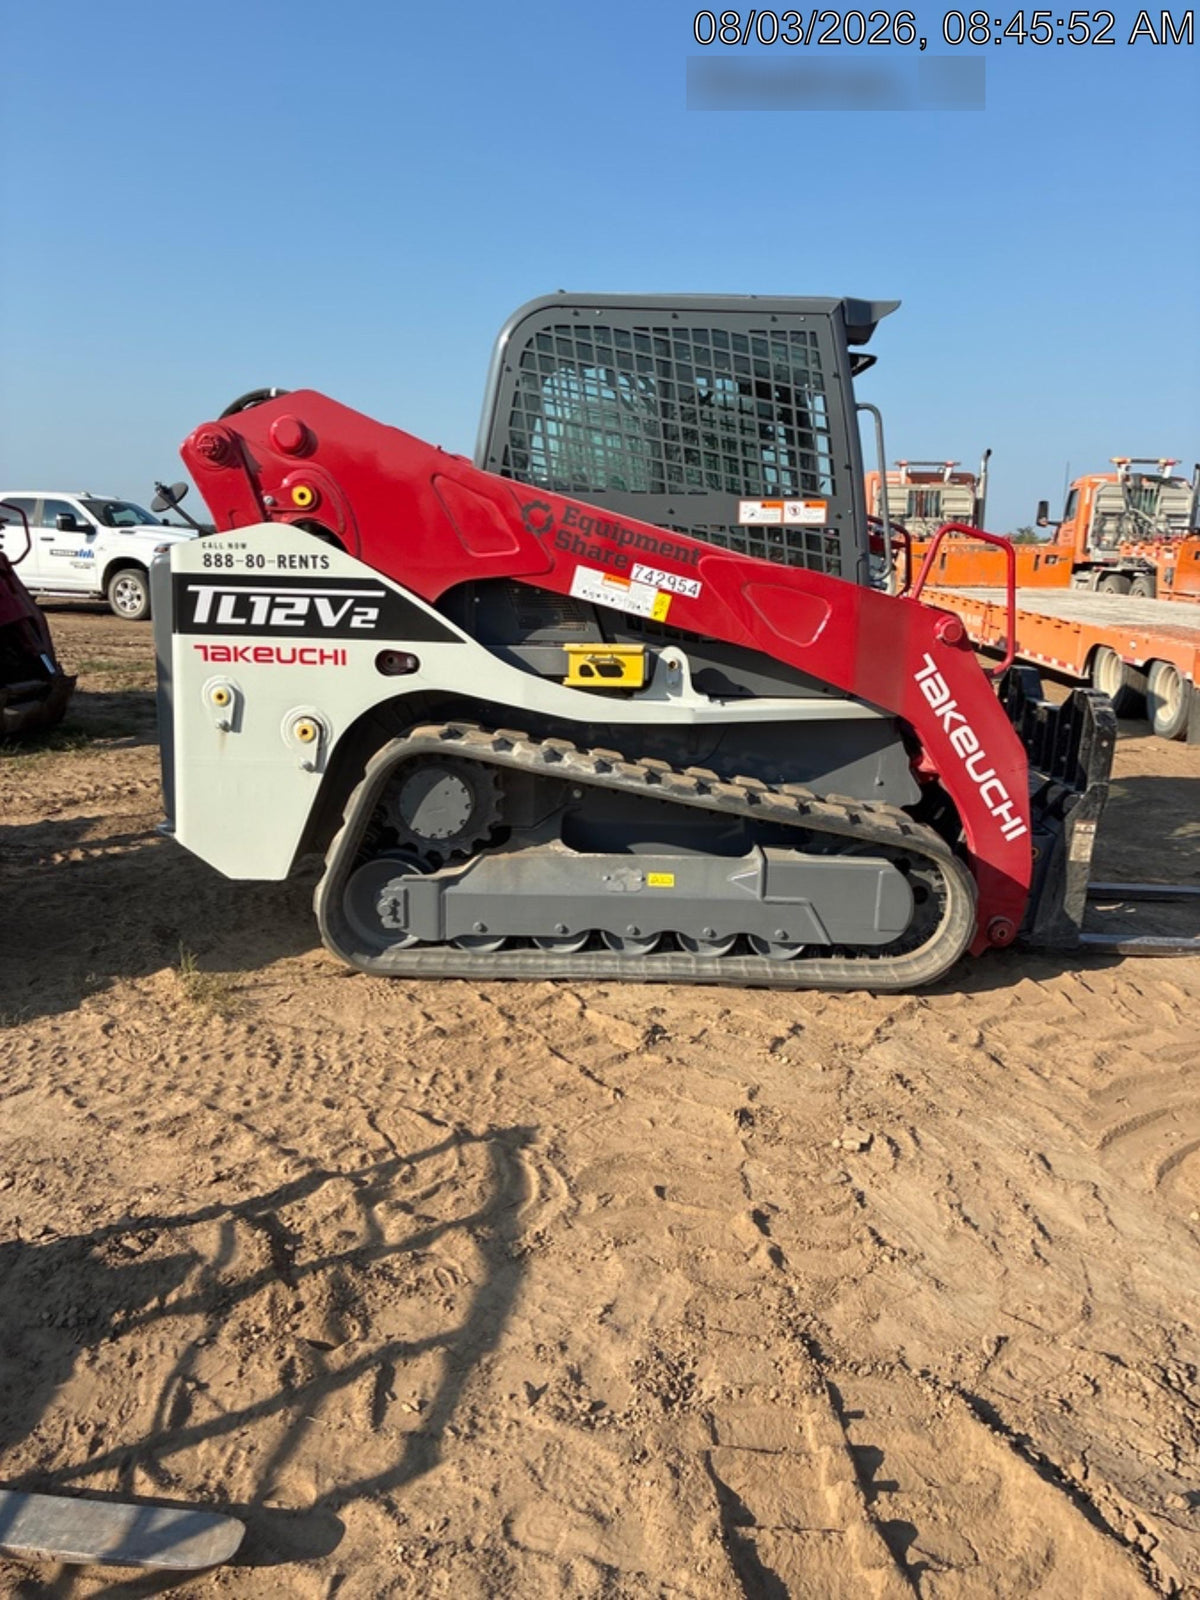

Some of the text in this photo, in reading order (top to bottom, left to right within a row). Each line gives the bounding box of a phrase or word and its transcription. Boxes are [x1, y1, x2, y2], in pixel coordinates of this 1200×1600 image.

[202, 542, 248, 550] CALL NOW
[554, 529, 629, 570] Share
[561, 505, 701, 566] Equipment
[203, 552, 331, 570] 888-80-RENTS
[634, 564, 699, 597] 742954
